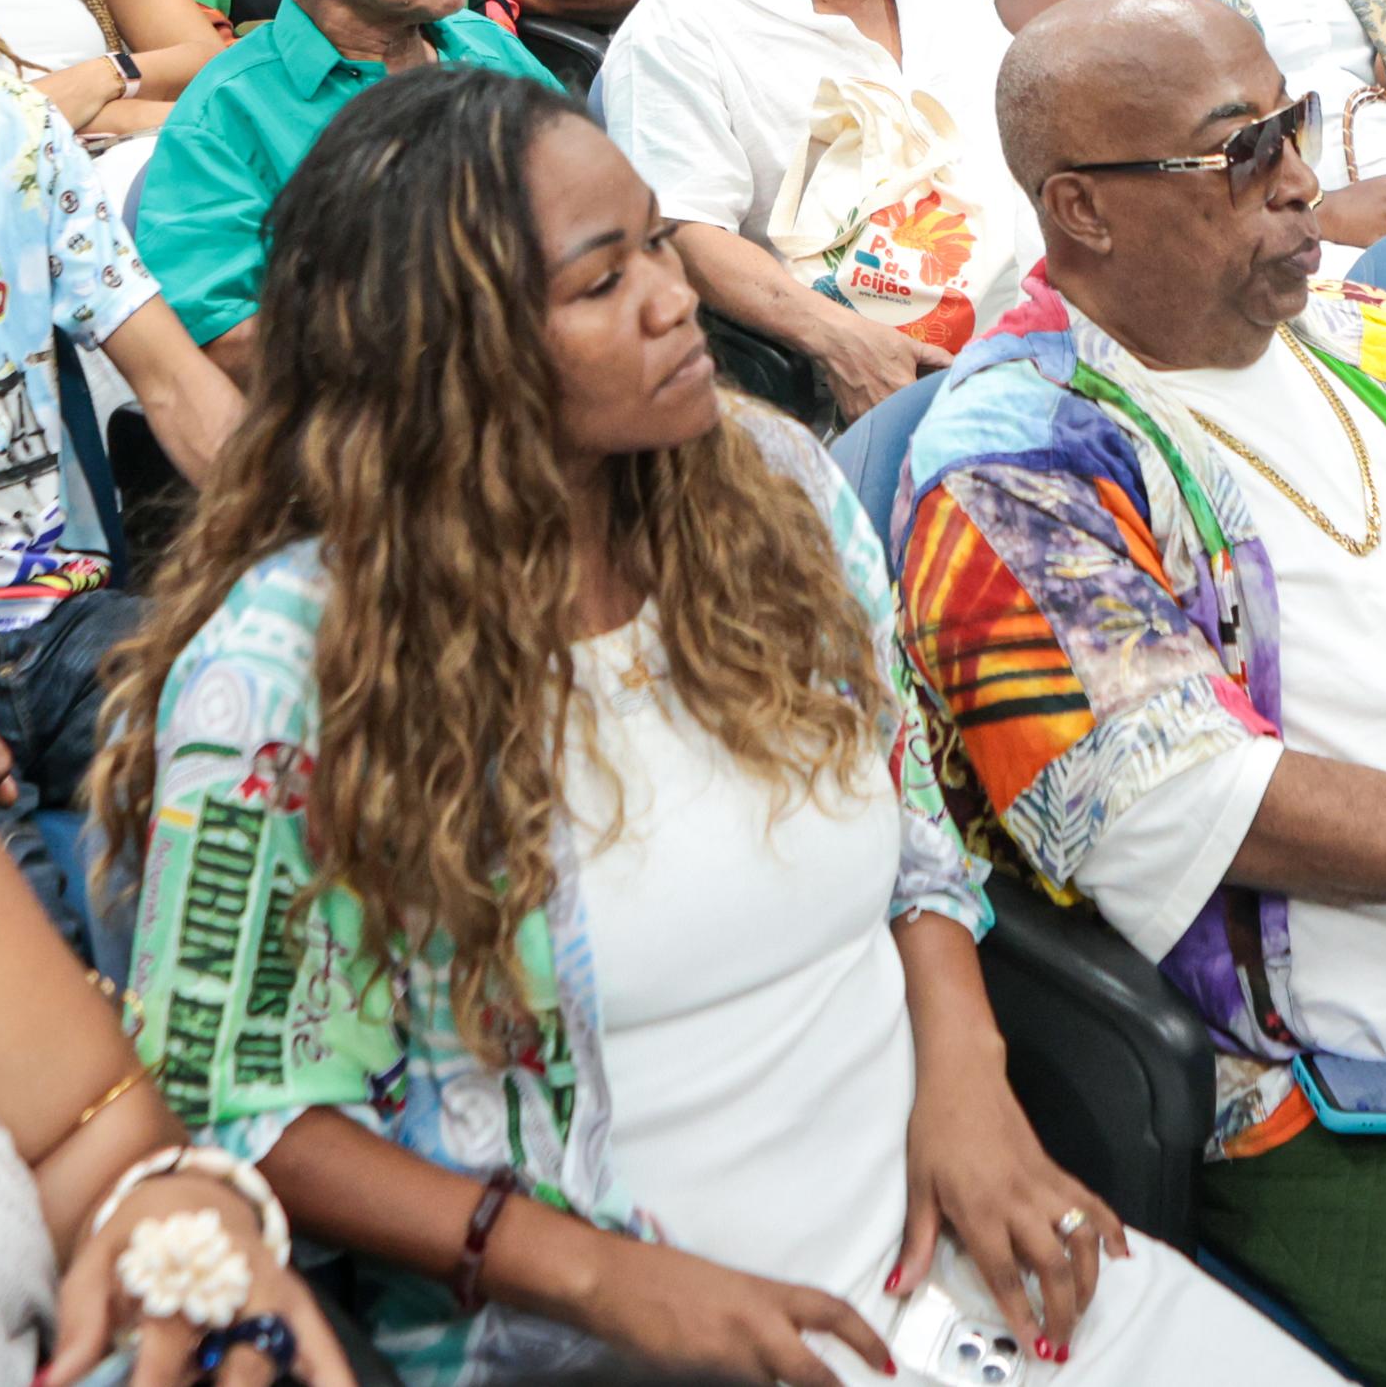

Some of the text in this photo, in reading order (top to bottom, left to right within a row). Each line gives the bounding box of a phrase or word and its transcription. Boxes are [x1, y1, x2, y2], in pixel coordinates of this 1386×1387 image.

[850, 266, 912, 296] feijão
[884, 261, 910, 280] de
[176, 795, 266, 981] KORIN
[233, 1031, 285, 1086] DE
